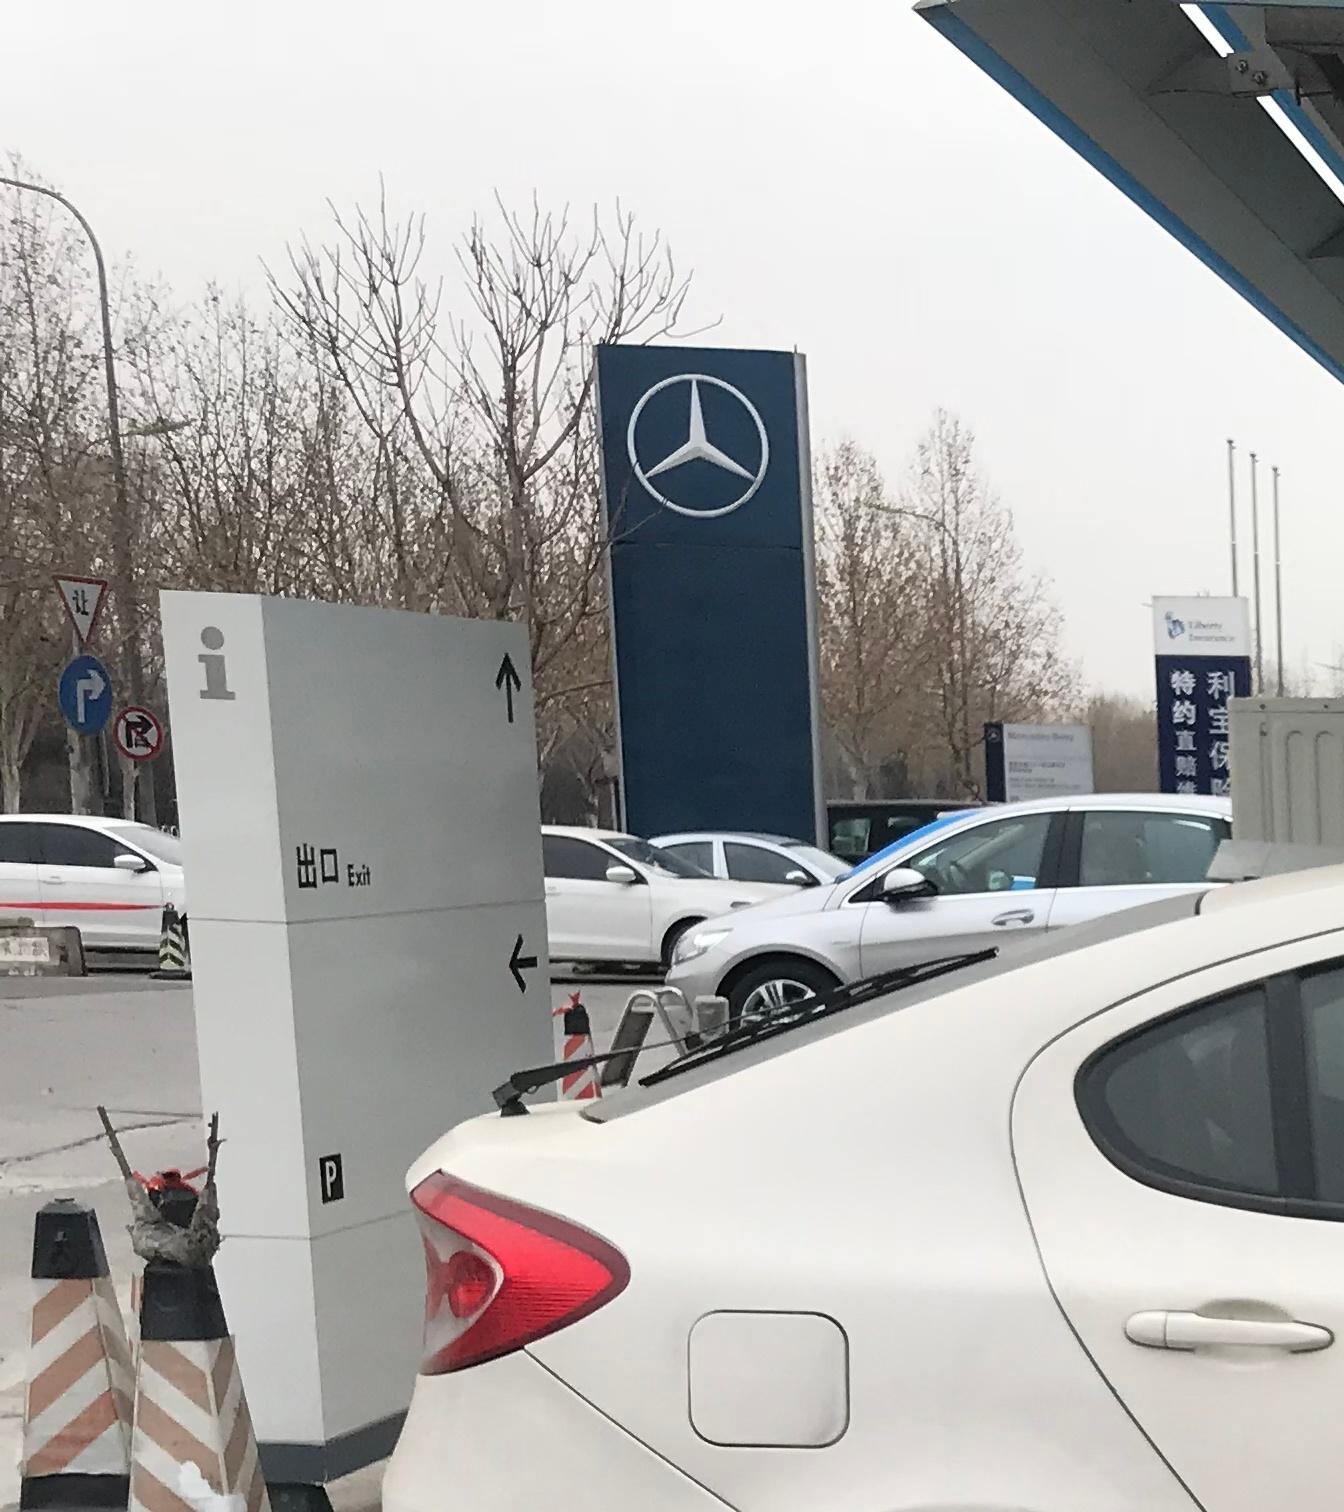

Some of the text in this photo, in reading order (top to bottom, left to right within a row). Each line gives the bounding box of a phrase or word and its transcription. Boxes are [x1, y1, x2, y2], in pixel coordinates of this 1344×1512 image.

[296, 842, 372, 888] 出口 Exit
[325, 1161, 337, 1197] P
